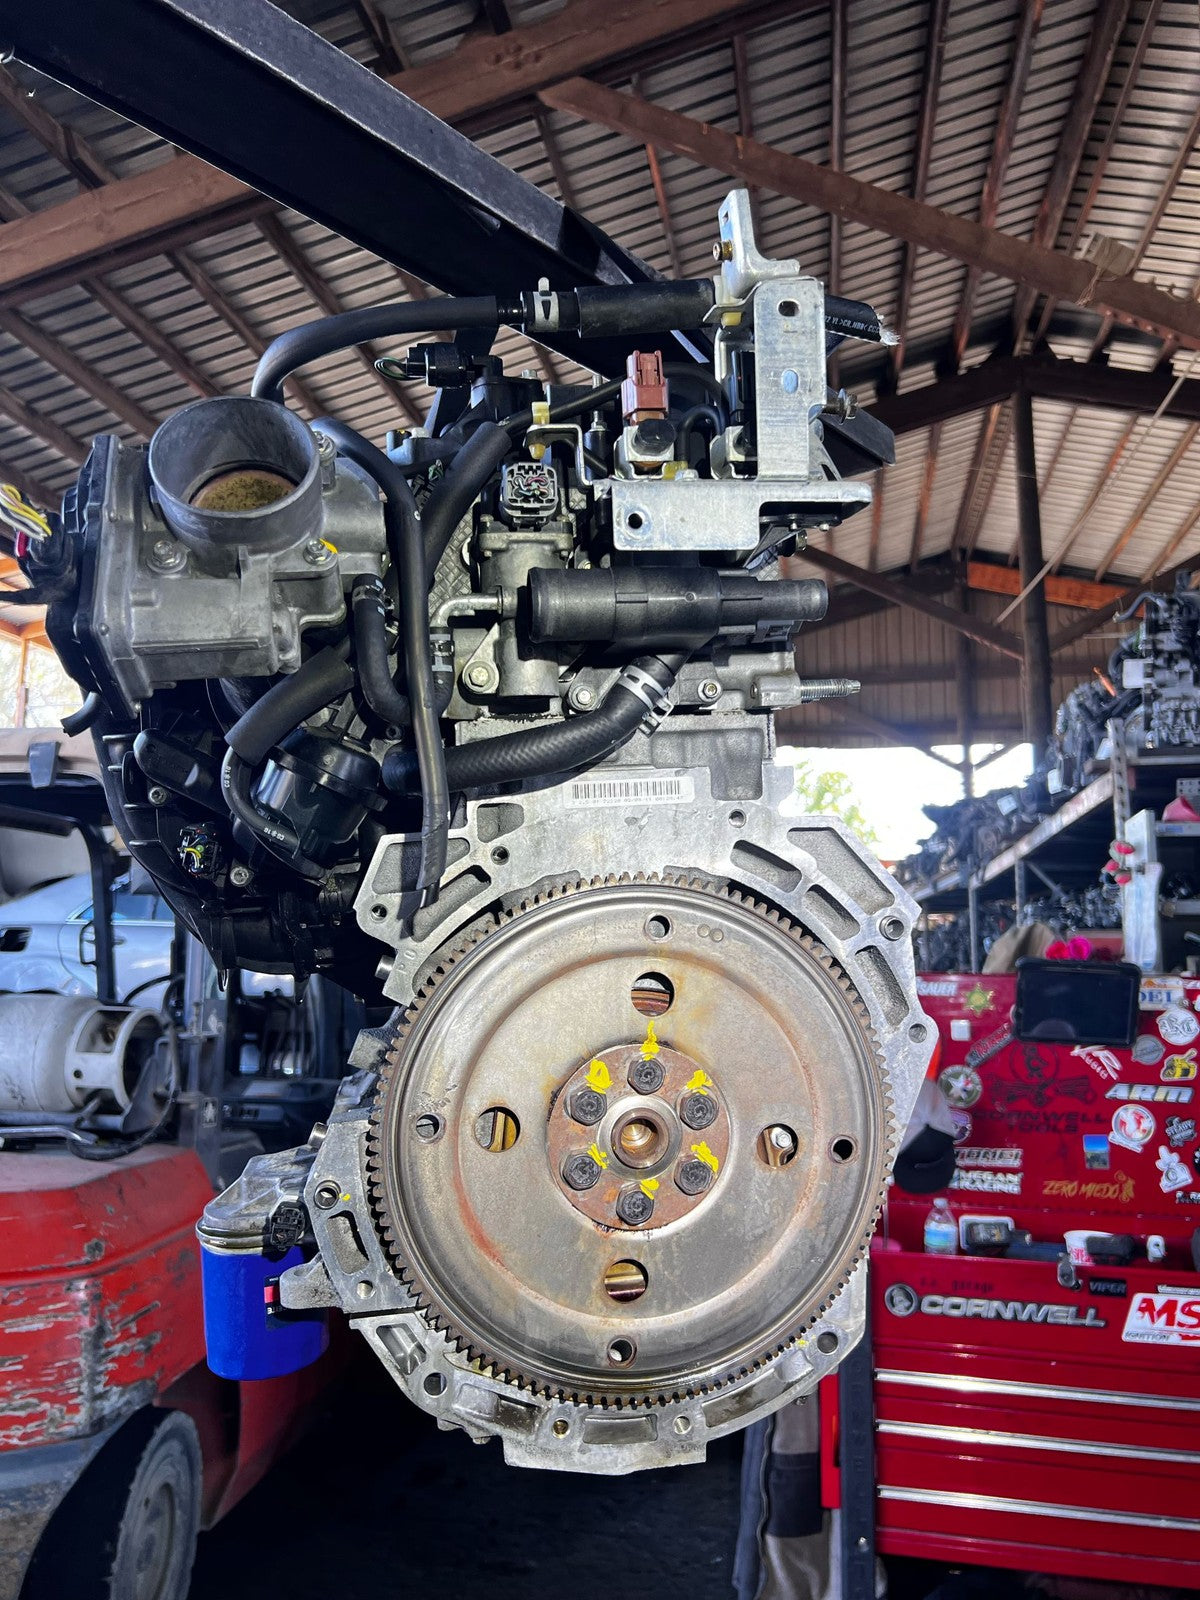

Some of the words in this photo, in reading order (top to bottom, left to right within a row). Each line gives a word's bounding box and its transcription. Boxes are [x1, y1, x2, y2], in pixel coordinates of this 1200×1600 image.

[970, 1109, 1108, 1124] CORNWELL
[1007, 1123, 1079, 1134] TOOLS
[958, 1170, 1023, 1185] MEGAN
[958, 1179, 1022, 1196] RACING
[1042, 1180, 1079, 1198] ZERO
[1079, 1182, 1120, 1199] MIEDO
[1089, 1281, 1126, 1294] VIPER
[920, 1294, 1106, 1328] CORNWELL
[1124, 1331, 1171, 1341] IGNITION
